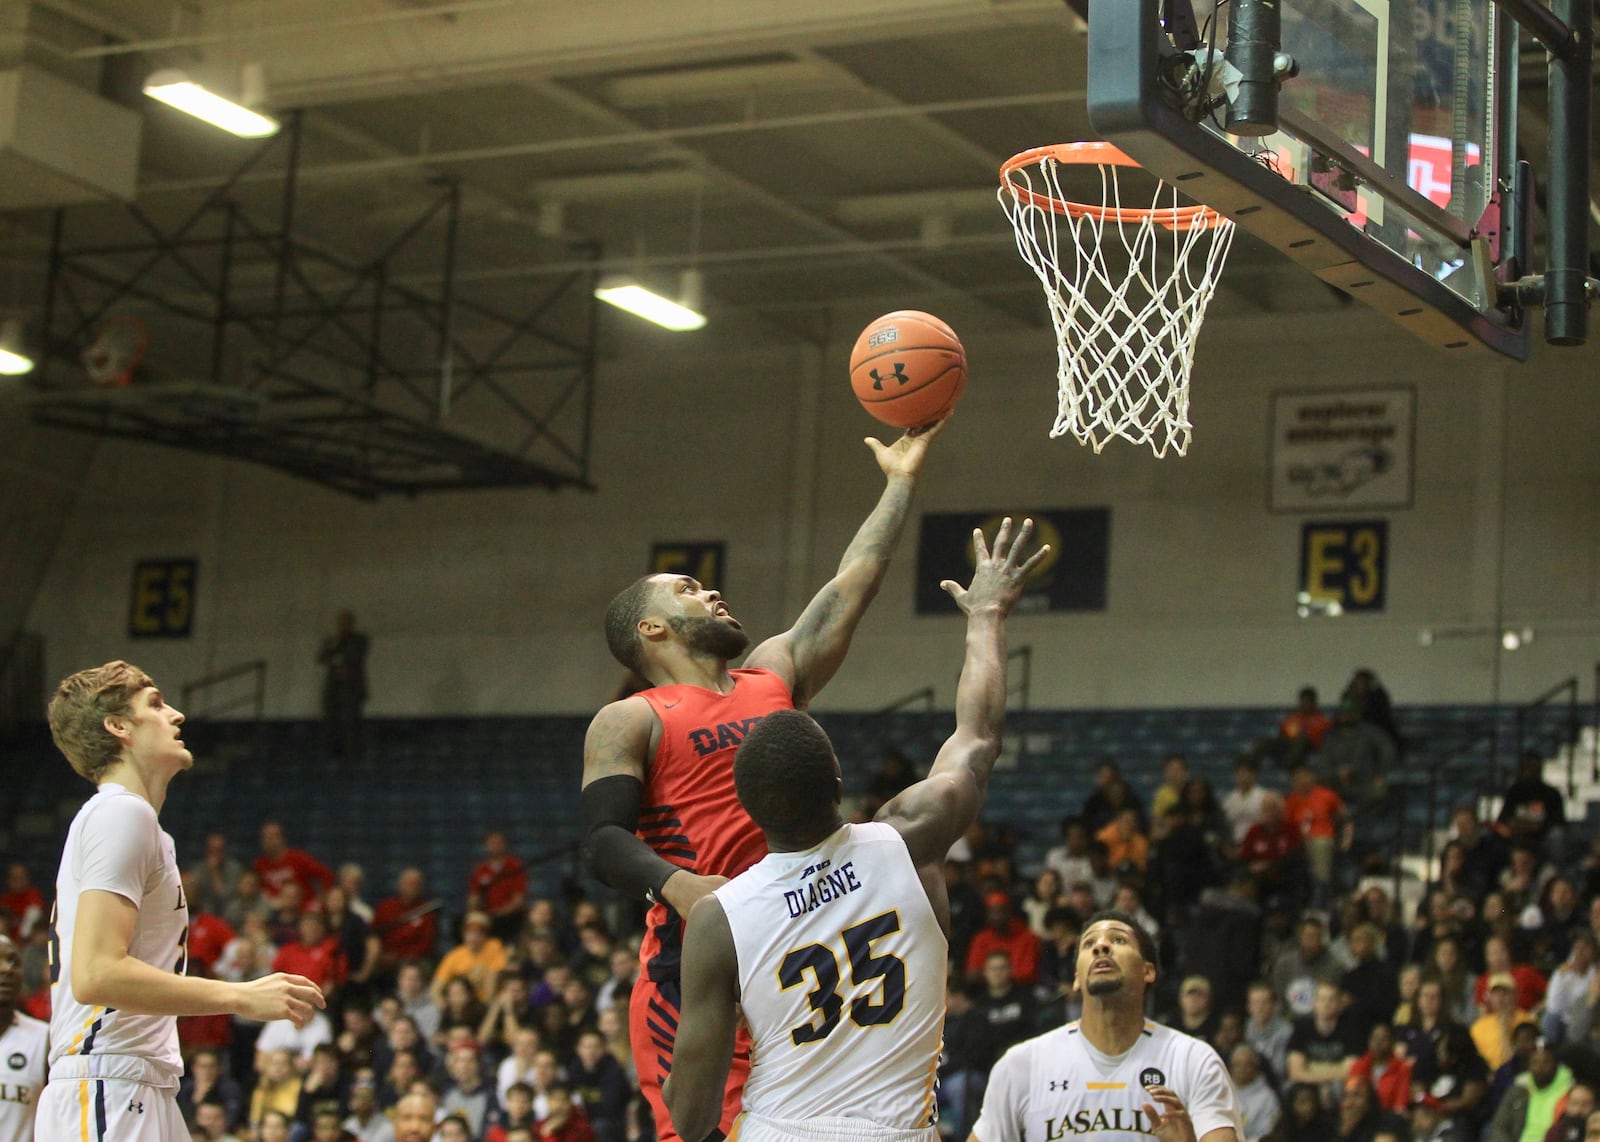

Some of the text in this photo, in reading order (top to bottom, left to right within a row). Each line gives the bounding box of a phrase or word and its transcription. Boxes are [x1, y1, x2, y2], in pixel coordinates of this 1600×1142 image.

[1307, 530, 1379, 604] E3
[134, 565, 190, 630] E5
[688, 716, 765, 756] DAY
[784, 861, 862, 919] DIAGNE
[776, 907, 908, 1047] 35
[1143, 1074, 1161, 1084] RB
[1045, 1108, 1157, 1142] LASALL
